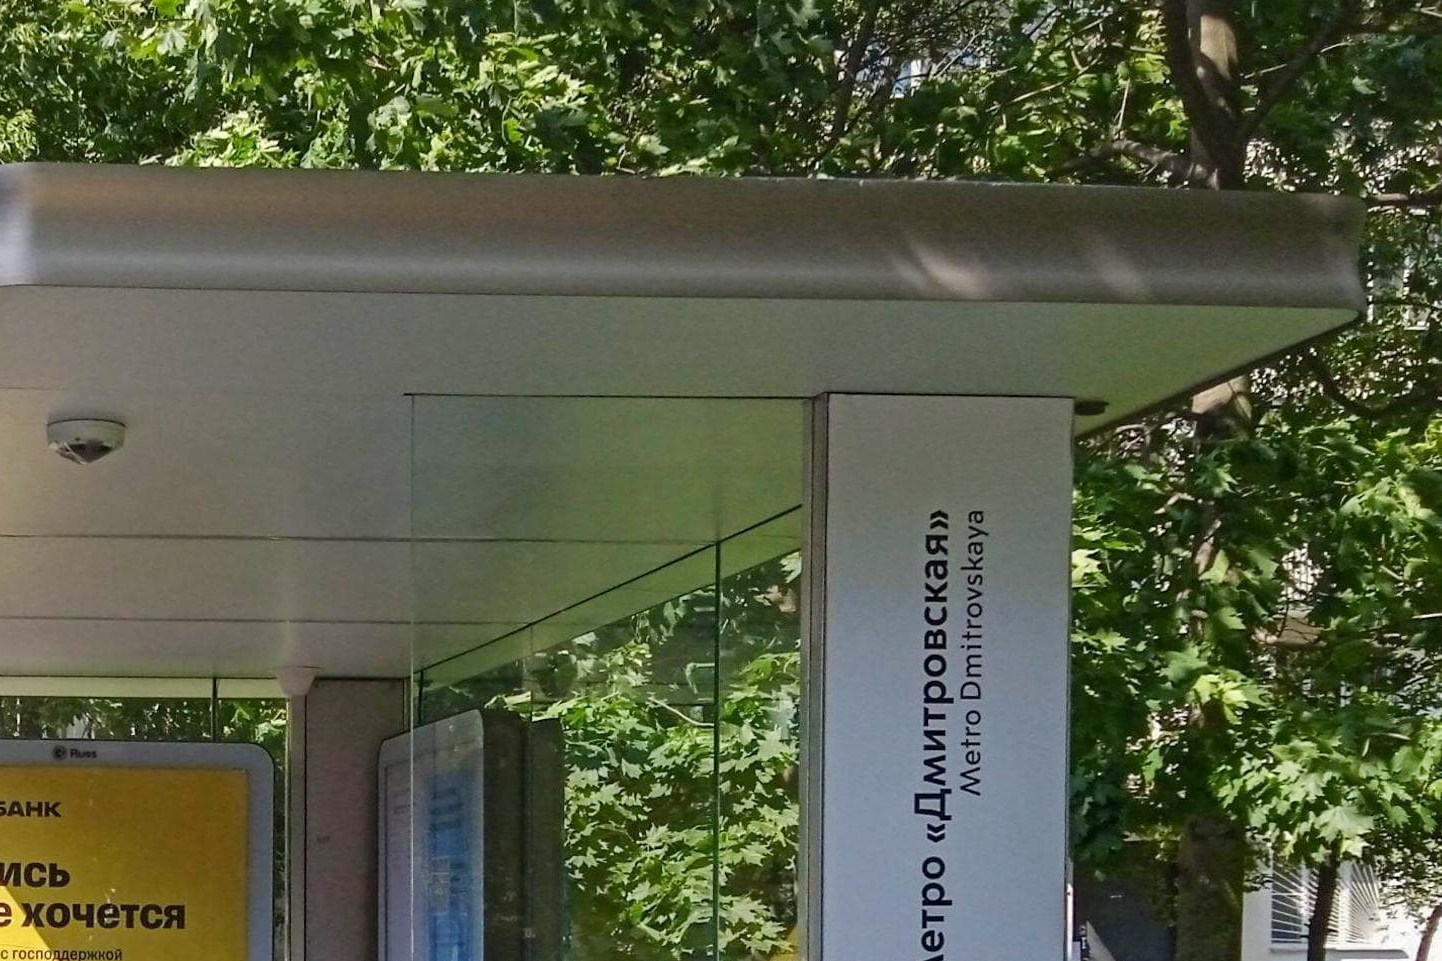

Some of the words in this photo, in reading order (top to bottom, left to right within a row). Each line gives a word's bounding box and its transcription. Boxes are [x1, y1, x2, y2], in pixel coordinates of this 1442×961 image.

[960, 509, 989, 700] Dmitrovskaya
[913, 509, 955, 844] «Дмитровская»
[959, 709, 982, 797] Metro
[0, 950, 9, 960] с
[21, 901, 186, 930] хочется
